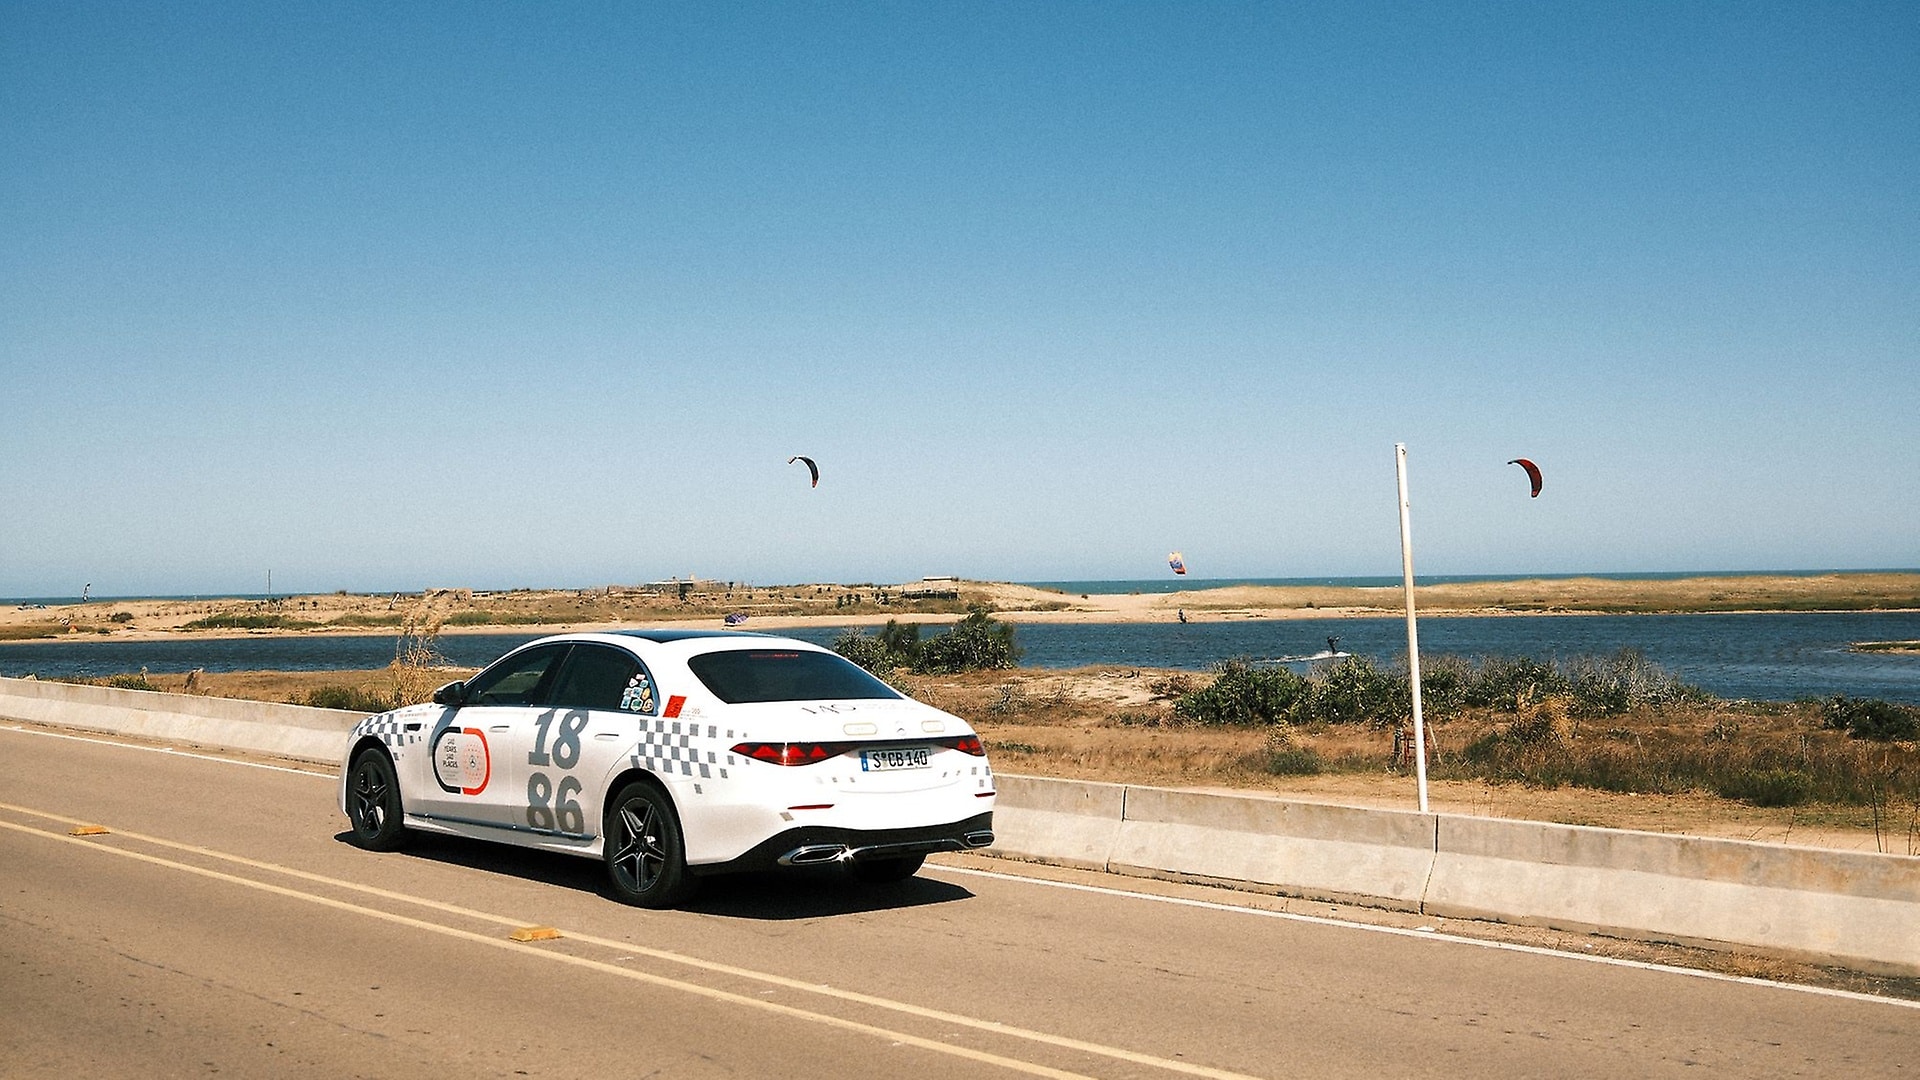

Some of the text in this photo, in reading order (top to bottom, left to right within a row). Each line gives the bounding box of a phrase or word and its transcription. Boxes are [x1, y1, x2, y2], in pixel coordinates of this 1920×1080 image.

[528, 708, 589, 770] 18
[888, 752, 904, 767] CB
[906, 751, 928, 766] 140
[526, 772, 584, 834] 86
